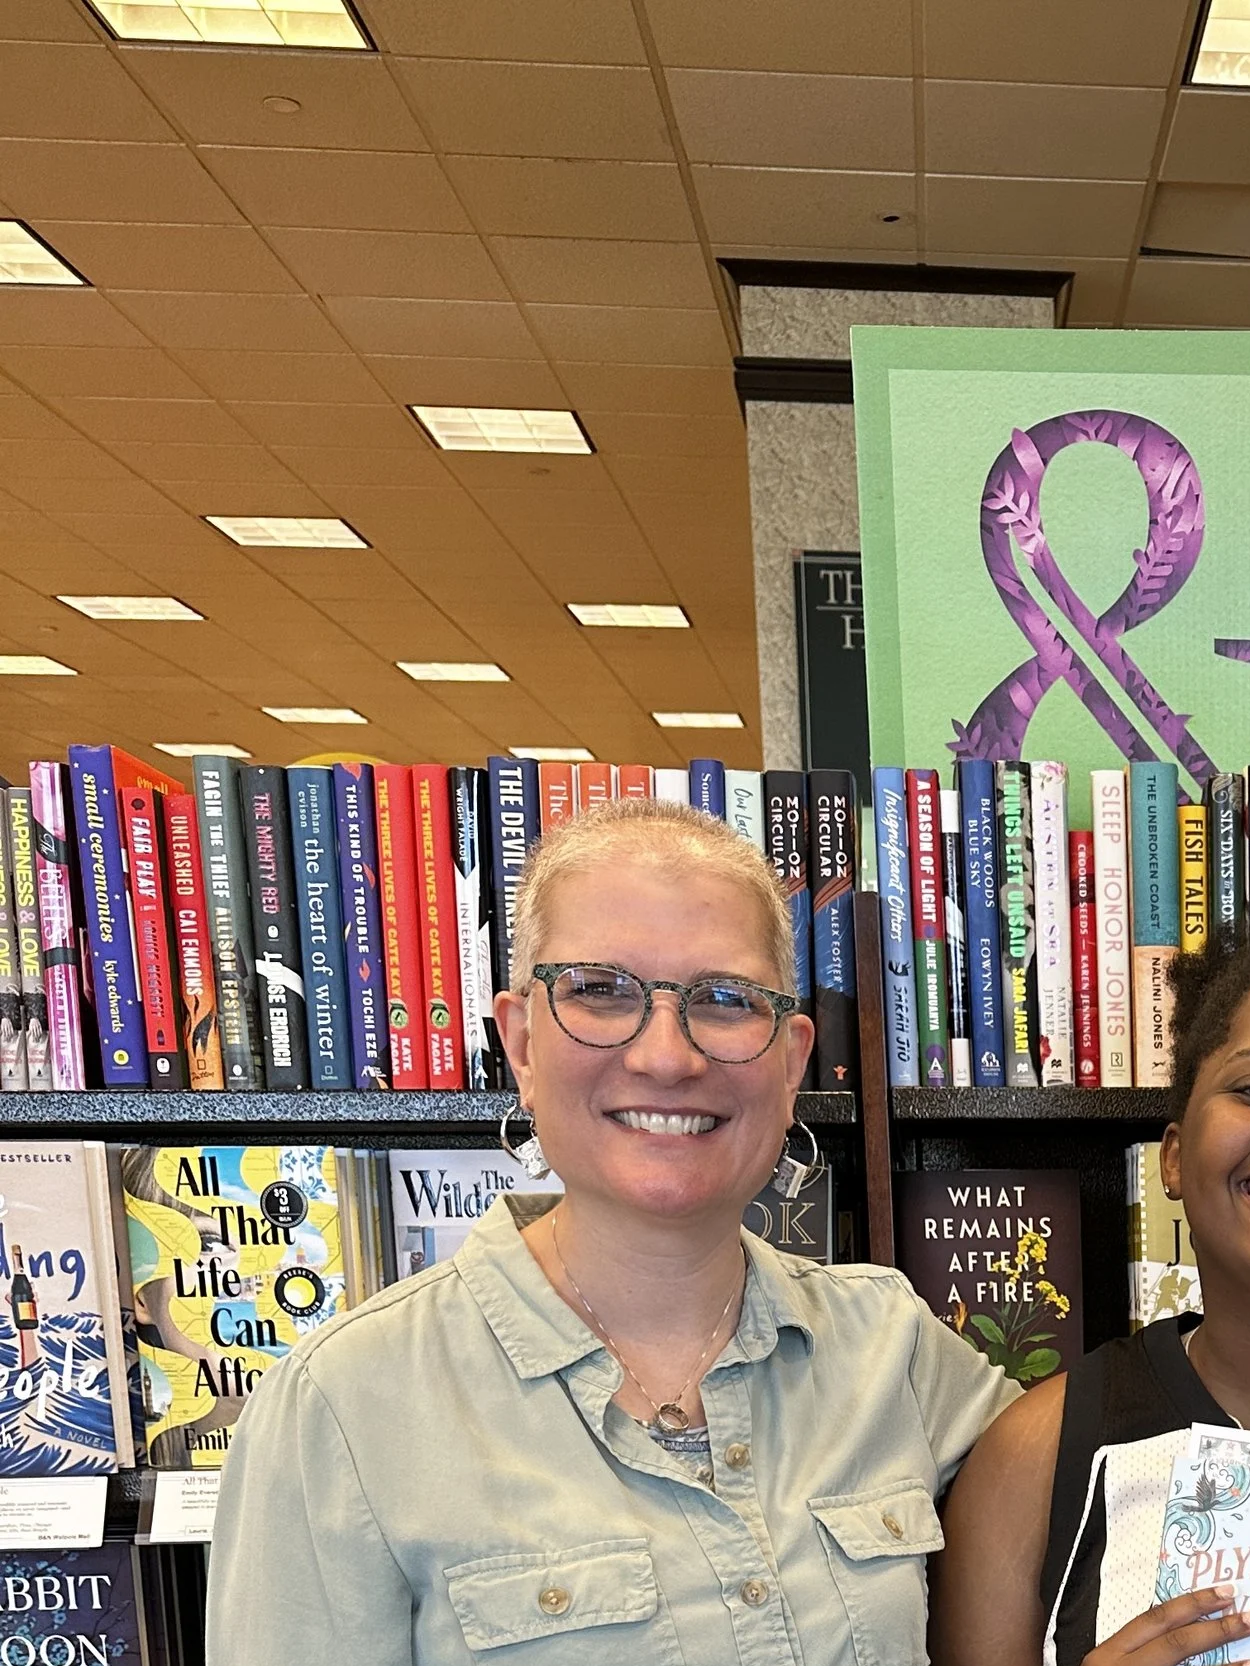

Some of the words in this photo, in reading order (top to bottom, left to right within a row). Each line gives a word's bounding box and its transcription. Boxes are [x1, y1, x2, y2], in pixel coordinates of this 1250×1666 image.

[82, 772, 100, 832] small
[917, 780, 932, 791] A
[1003, 771, 1021, 837] THINGS
[131, 817, 152, 854] FAIR
[818, 796, 832, 878] CIRCULAR
[833, 796, 847, 878] MOTION
[917, 795, 934, 847] SEASON
[980, 799, 991, 844] BLACK
[1102, 786, 1120, 845] SLEEP
[304, 839, 324, 873] the
[881, 788, 905, 893] Insignificant
[968, 819, 980, 857] BLUE
[1185, 819, 1204, 862] FISH
[135, 858, 157, 899] PLAY
[919, 851, 935, 869] OF
[969, 861, 981, 889] SKY
[983, 849, 995, 908] WOODS
[1005, 844, 1023, 886] LEFT
[87, 834, 114, 943] ceremonies
[921, 871, 936, 923] LIGHT
[1185, 875, 1204, 936] TALES
[307, 882, 328, 944] heart
[887, 895, 907, 942] Others
[1007, 888, 1026, 957] UNSAID
[1104, 868, 1123, 953] HONOR
[312, 953, 333, 976] of
[315, 984, 337, 1059] winter
[1106, 968, 1125, 1036] JONES
[175, 1157, 220, 1198] All
[481, 1170, 514, 1189] The
[948, 1186, 1026, 1208] WHAT
[212, 1206, 296, 1248] That
[924, 1217, 1052, 1239] REMAINS
[174, 1258, 242, 1299] Life
[949, 1251, 1029, 1272] AFTER
[948, 1282, 962, 1303] A
[978, 1281, 1034, 1302] FIRE
[210, 1307, 277, 1348] Can
